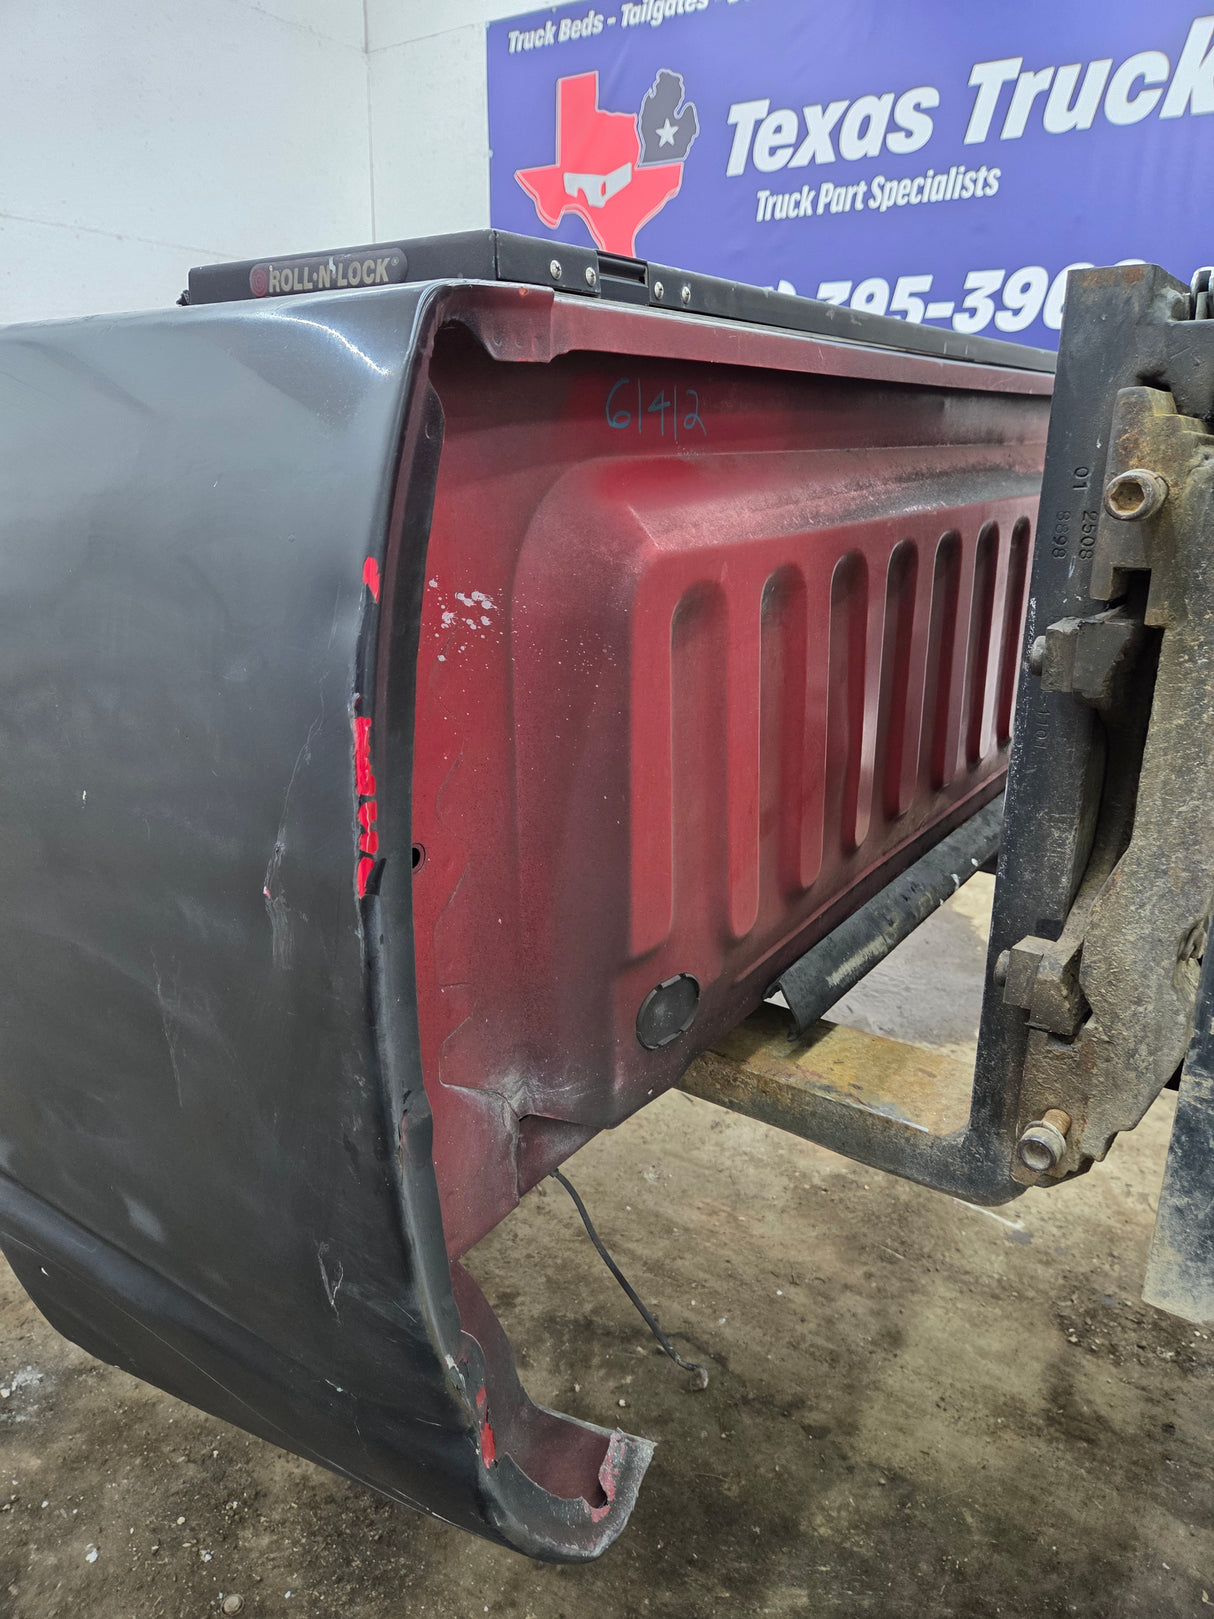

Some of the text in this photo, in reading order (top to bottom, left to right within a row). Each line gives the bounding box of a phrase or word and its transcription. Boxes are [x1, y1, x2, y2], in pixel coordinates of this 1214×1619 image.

[508, 20, 557, 54] Truck
[557, 9, 604, 42] Beds
[726, 14, 1214, 177] Texas Truck
[756, 165, 1001, 222] Truck Part Specialists
